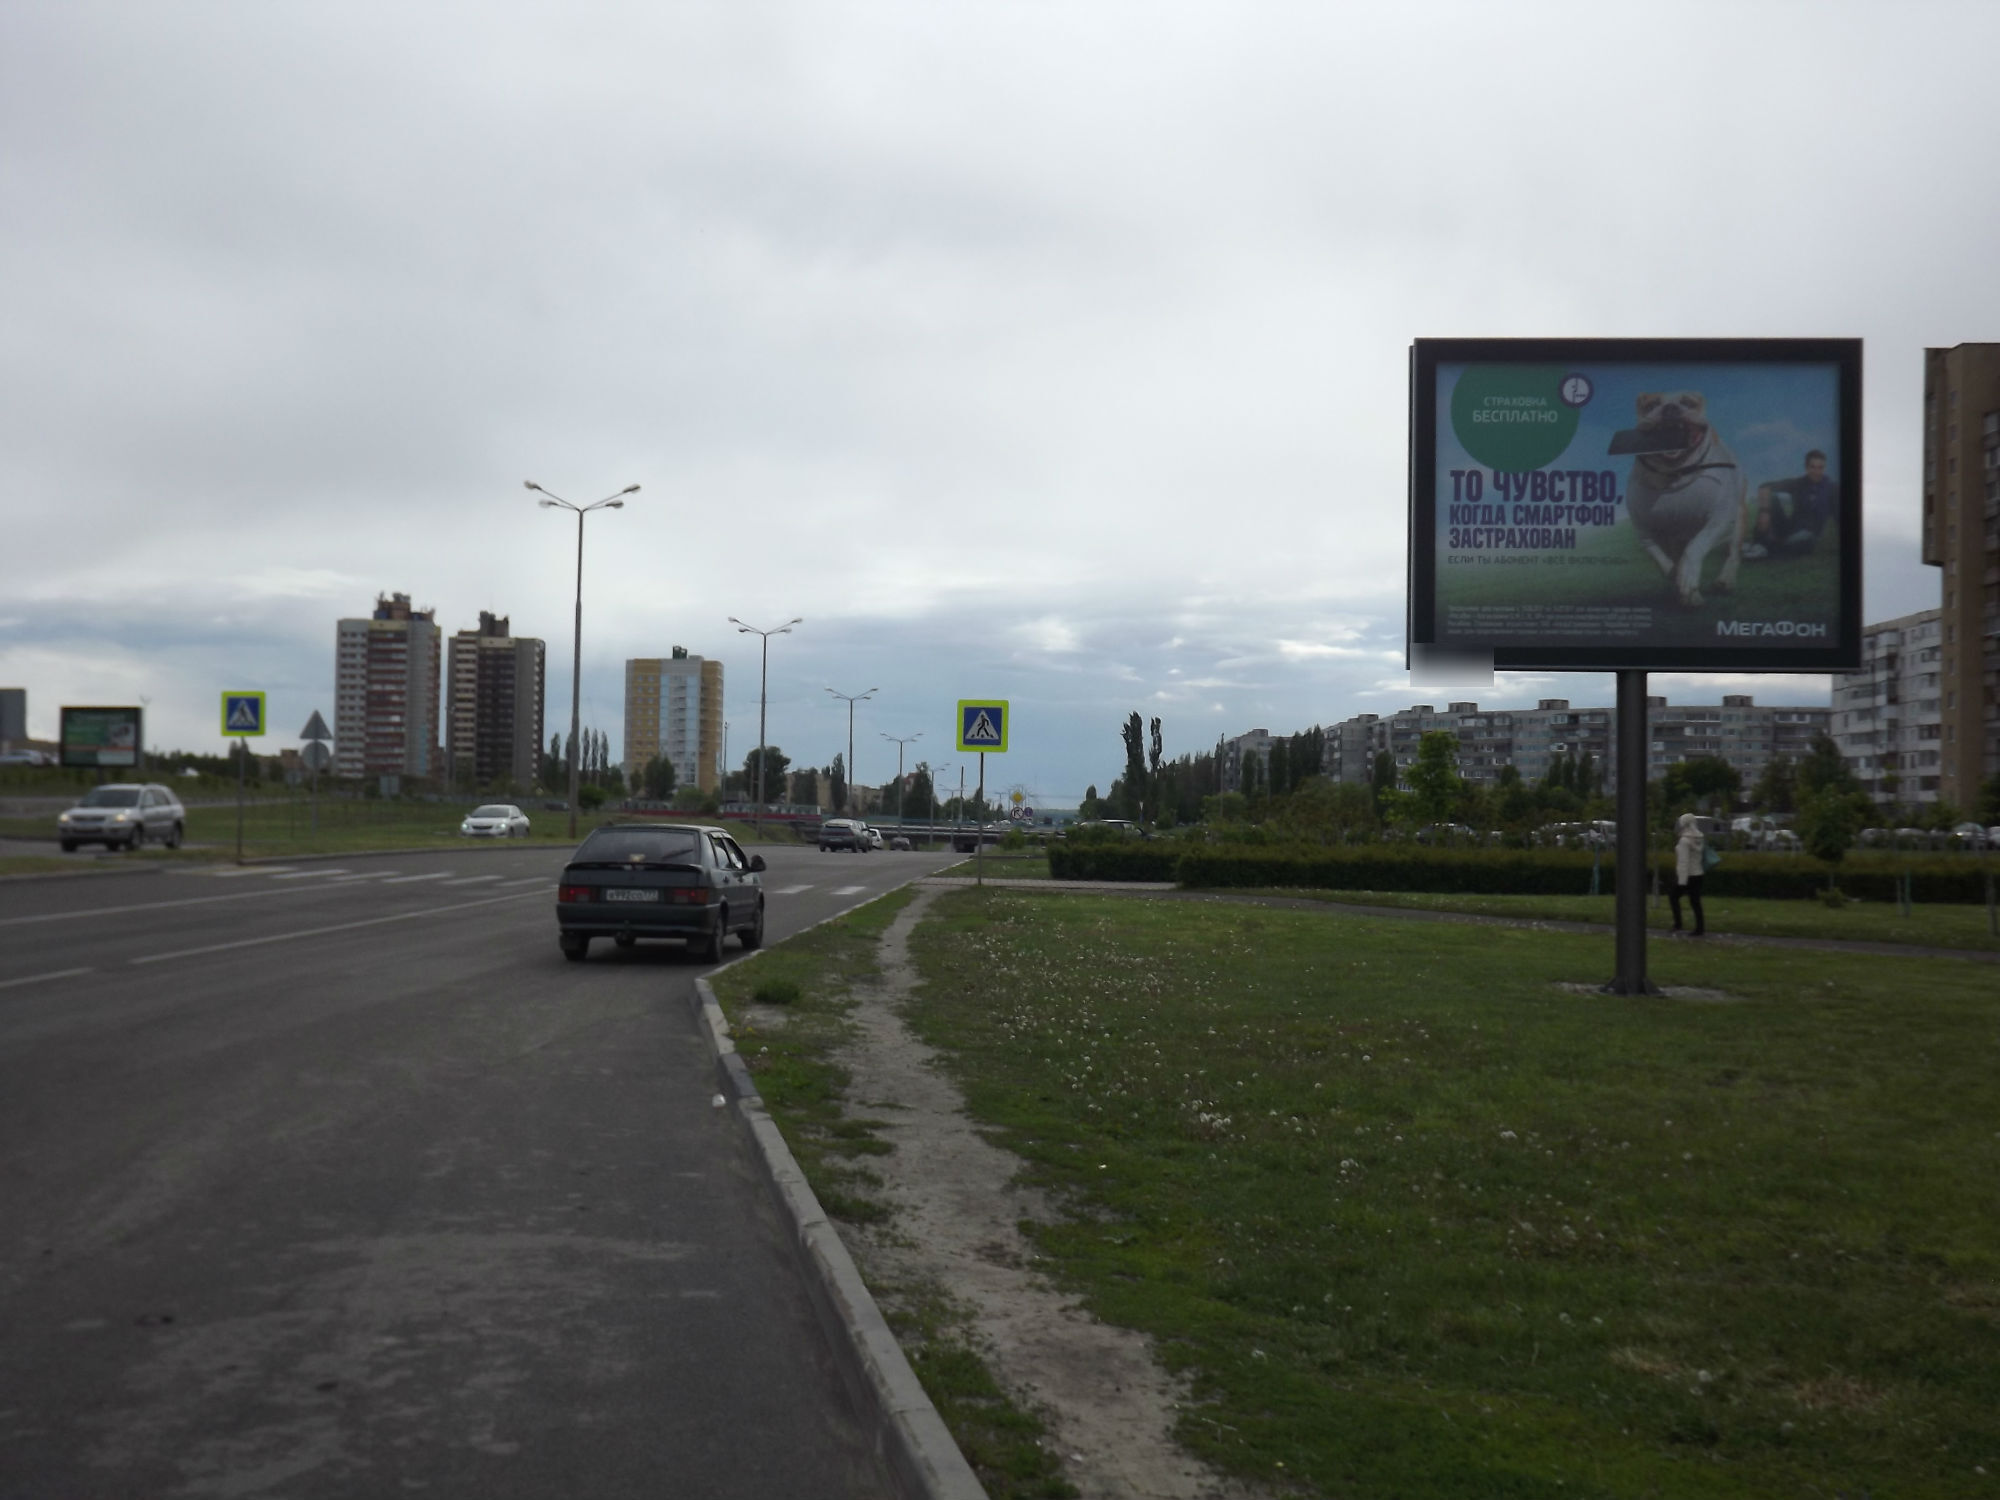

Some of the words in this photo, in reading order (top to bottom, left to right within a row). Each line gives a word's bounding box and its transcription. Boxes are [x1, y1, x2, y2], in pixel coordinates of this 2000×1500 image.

[1484, 397, 1547, 406] СТРАХОВКА
[1472, 410, 1558, 423] БЕСПЛАТНО
[1450, 470, 1483, 502] ТО
[1493, 470, 1625, 505] ЧУВСТВО,
[1449, 504, 1506, 526] КОГДА
[1513, 504, 1615, 526] СМАРТФОН
[1449, 528, 1576, 549] ЗАСТРАХОВАН
[1448, 555, 1474, 565] ЕСЛИ
[1477, 555, 1491, 565] ТЫ
[1494, 555, 1538, 565] АБОНЕНТ
